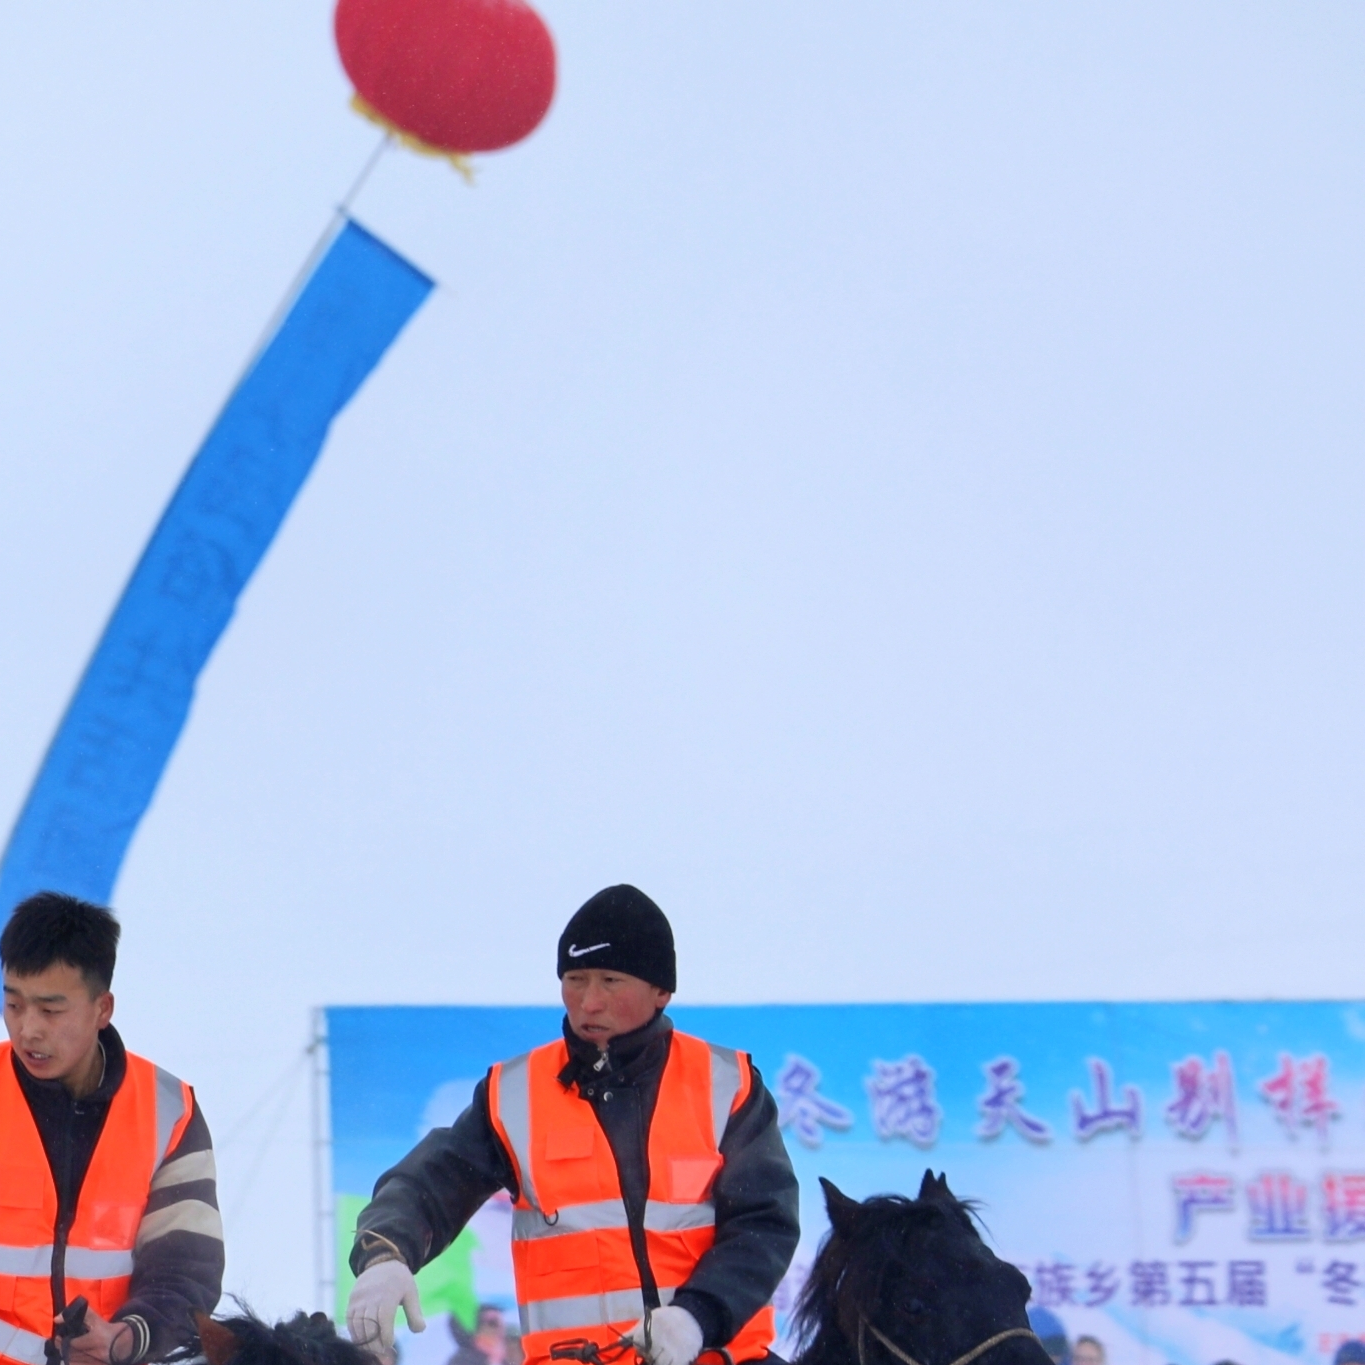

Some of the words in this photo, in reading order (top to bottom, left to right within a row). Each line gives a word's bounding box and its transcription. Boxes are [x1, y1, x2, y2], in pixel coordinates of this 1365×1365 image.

[1019, 1258, 1361, 1306] 族乡第五届“冬
